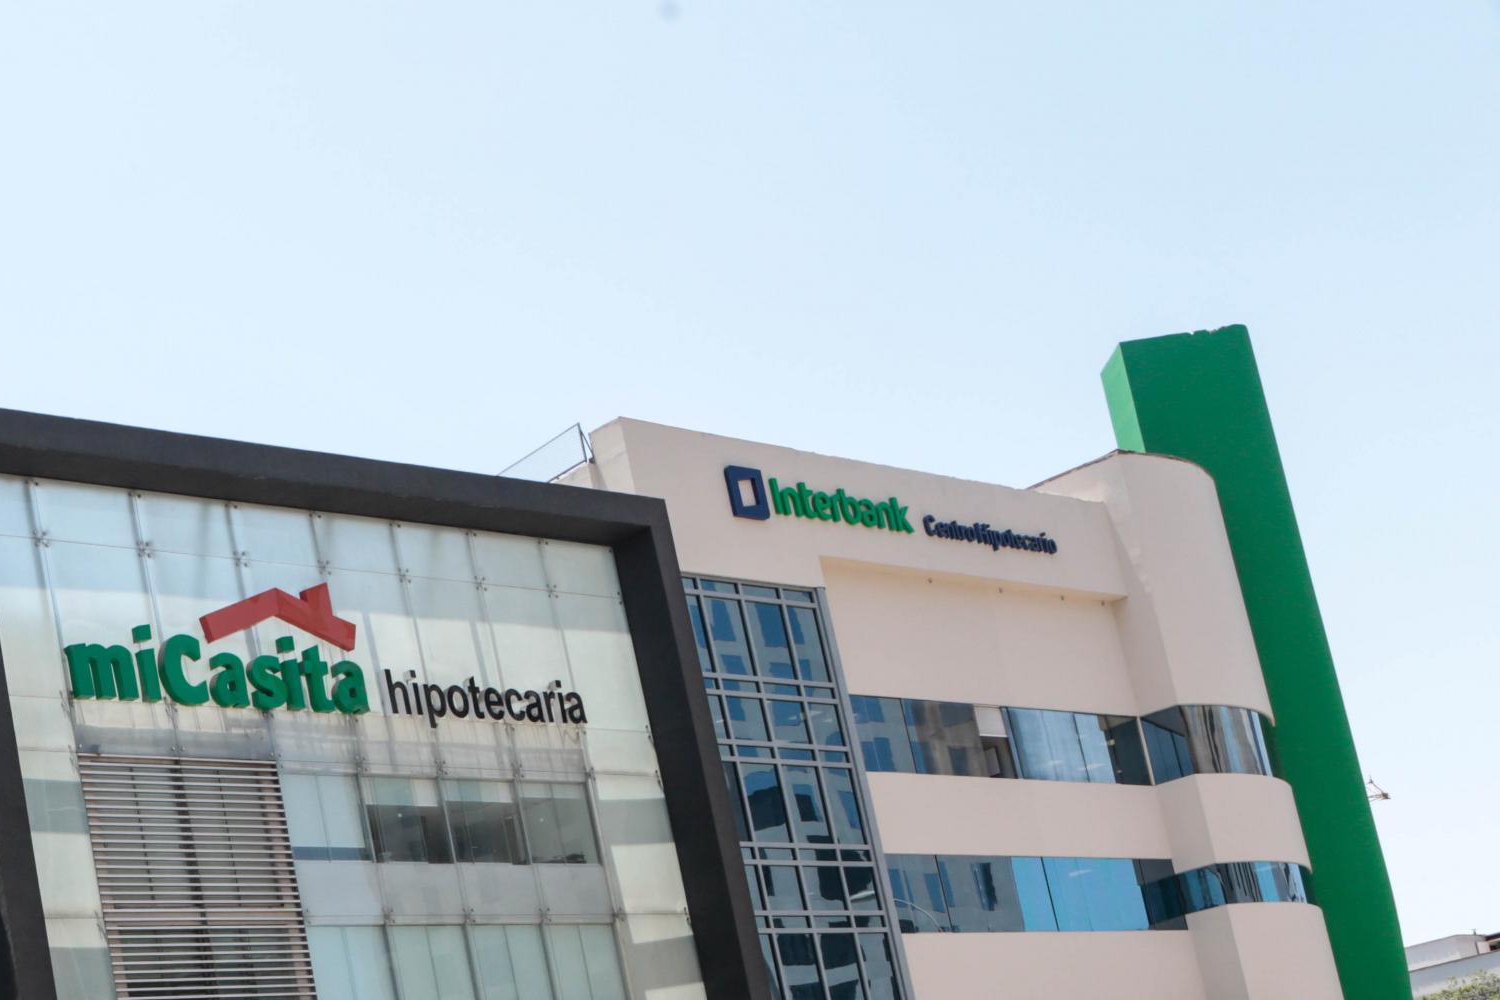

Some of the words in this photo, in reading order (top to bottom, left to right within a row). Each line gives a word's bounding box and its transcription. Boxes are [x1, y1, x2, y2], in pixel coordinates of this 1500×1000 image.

[768, 477, 915, 534] Interbank
[64, 623, 371, 716] miCasita
[383, 668, 589, 729] hipotecaria
